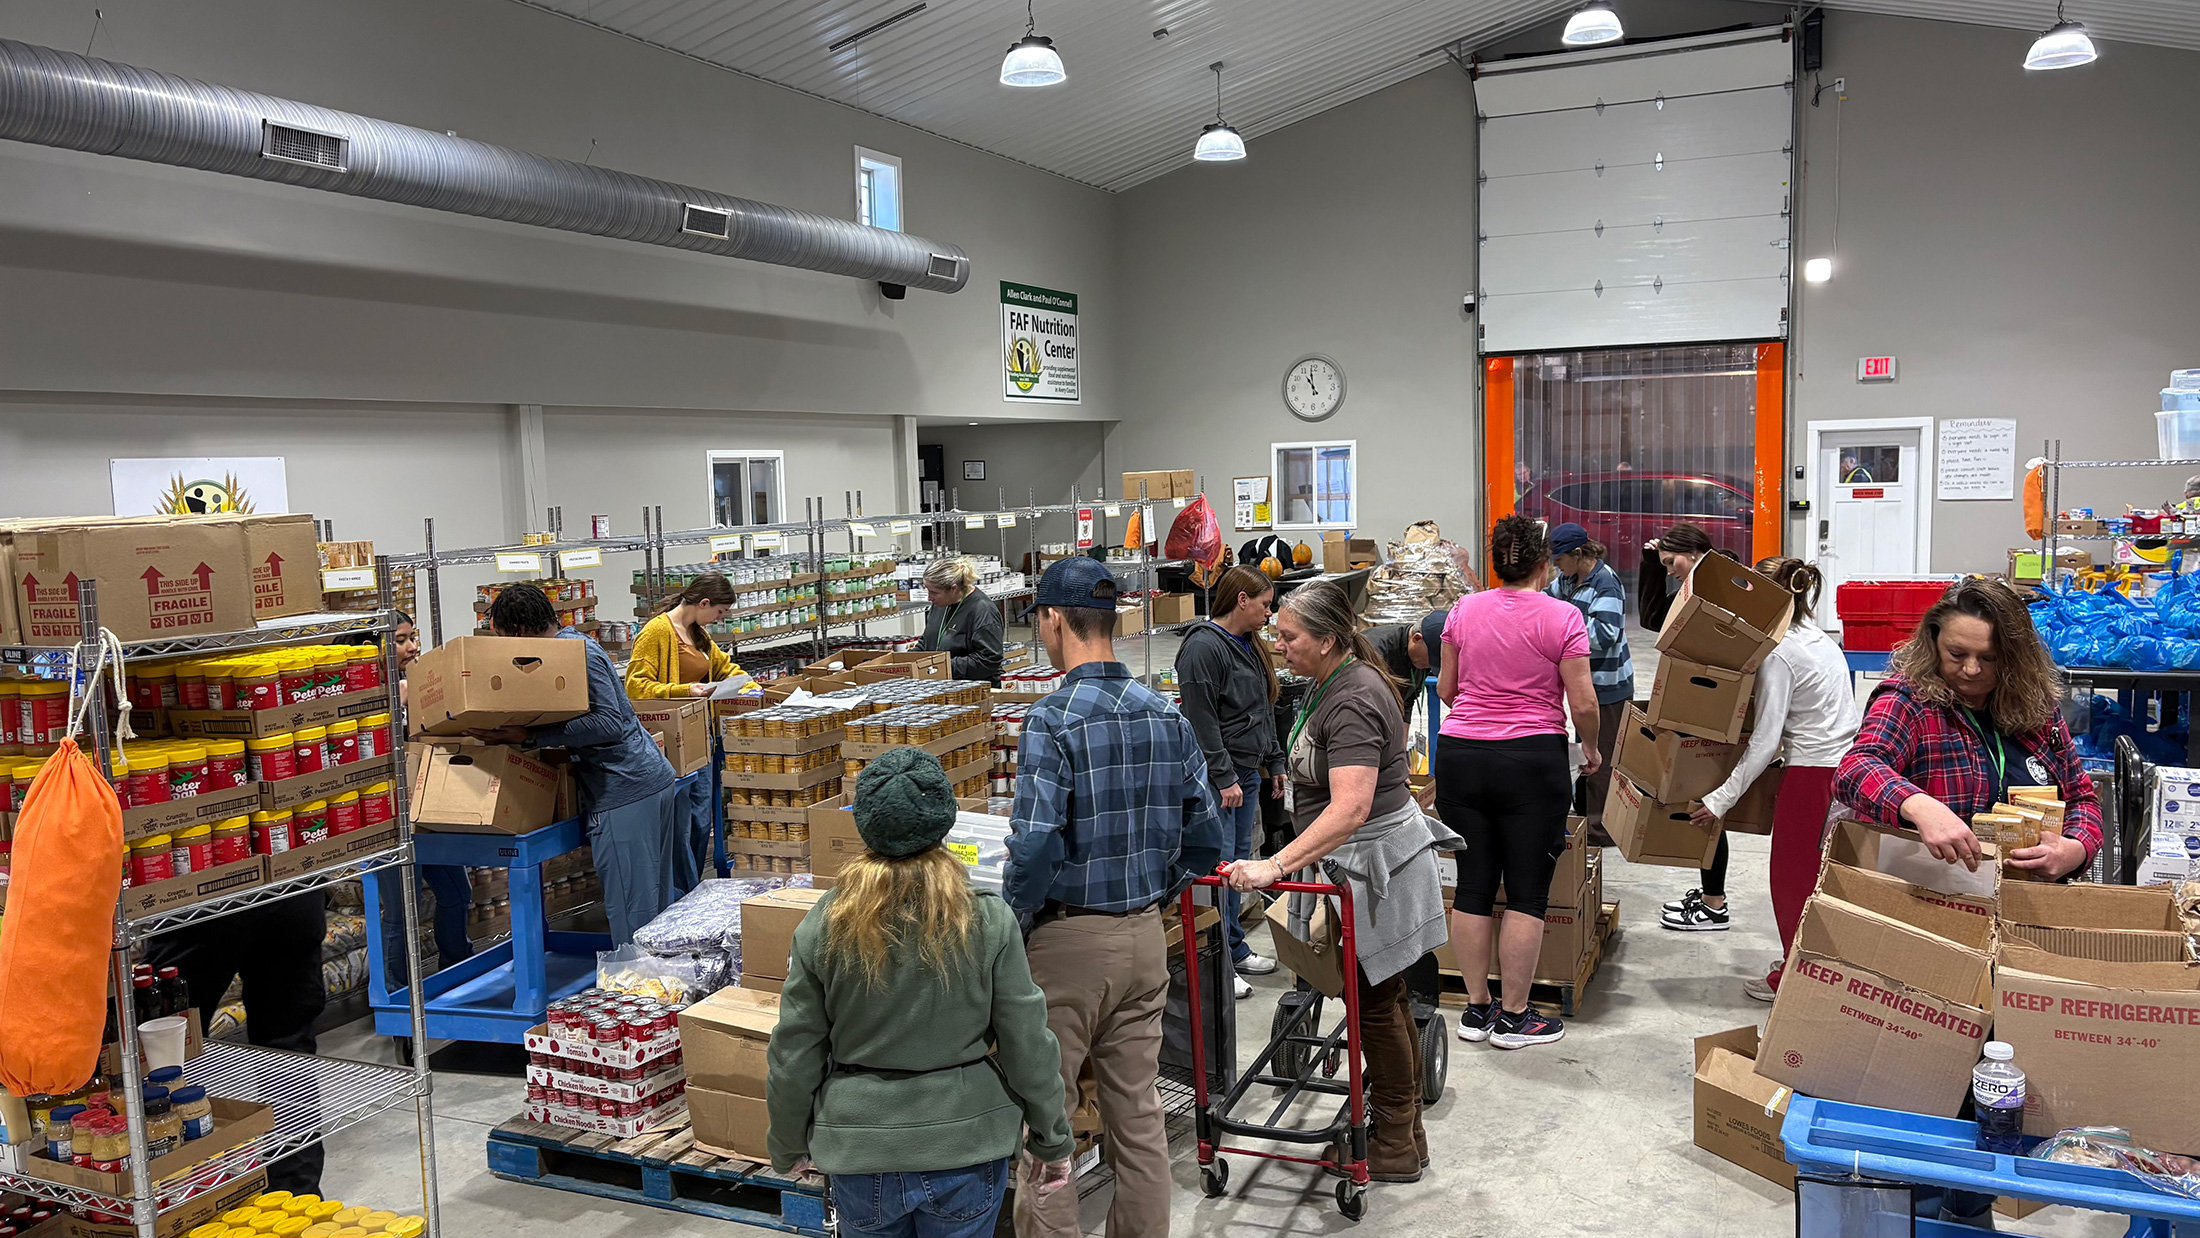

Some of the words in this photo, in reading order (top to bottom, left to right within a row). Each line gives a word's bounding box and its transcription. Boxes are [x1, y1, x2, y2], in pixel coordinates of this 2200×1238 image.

[1007, 289, 1019, 299] Allen
[1020, 291, 1032, 300] Clark
[1032, 292, 1041, 303] and
[1042, 294, 1051, 304] Paul
[1052, 297, 1073, 308] O'Connell
[1010, 311, 1029, 331] FAF
[1032, 314, 1075, 337] Nutrition
[1044, 340, 1075, 359] Center
[1865, 358, 1890, 375] EXIT
[1330, 383, 1336, 391] 3
[1311, 403, 1316, 411] 6
[1950, 419, 1992, 428] Reminders
[160, 580, 173, 588] THIS
[175, 579, 189, 587] SIDE
[254, 583, 279, 594] GILE
[36, 588, 47, 596] THIS
[154, 597, 208, 612] FRAGILE
[33, 608, 76, 619] FRAGILE
[5, 650, 21, 659] ULINE
[876, 666, 910, 674] FRIGERATED
[316, 684, 346, 695] Peter
[638, 713, 670, 721] GERATED
[507, 754, 522, 764] KEEP
[522, 760, 558, 781] REFRIGERATED
[320, 780, 338, 788] Crunchy
[160, 820, 178, 828] Peanut
[179, 816, 195, 824] Butter
[166, 812, 188, 821] Crunchy
[301, 827, 328, 840] Peter
[322, 848, 341, 857] Crunchy
[333, 852, 346, 860] Butter
[160, 896, 177, 904] Peanut
[178, 892, 193, 900] Butter
[167, 888, 187, 897] Creamy
[1796, 959, 1844, 986] KEEP
[1846, 977, 1983, 1040] REFRIGERATED
[2002, 990, 2054, 1012] KEEP
[2061, 998, 2200, 1026] REFRIGERATE
[1839, 1004, 1885, 1028] BETWEEN
[2054, 1029, 2112, 1045] BETWEEN
[566, 1047, 588, 1058] Tomato
[654, 1042, 675, 1055] Tomato
[558, 1079, 578, 1090] Chicken
[579, 1084, 599, 1094] Noodle
[1975, 1077, 2008, 1094] ZERO
[650, 1112, 665, 1124] Chicken
[665, 1105, 680, 1118] Noodle
[554, 1115, 575, 1126] Chicken
[576, 1119, 596, 1130] Noodle
[1729, 1117, 1750, 1131] LOWES
[1750, 1126, 1771, 1140] FOODS
